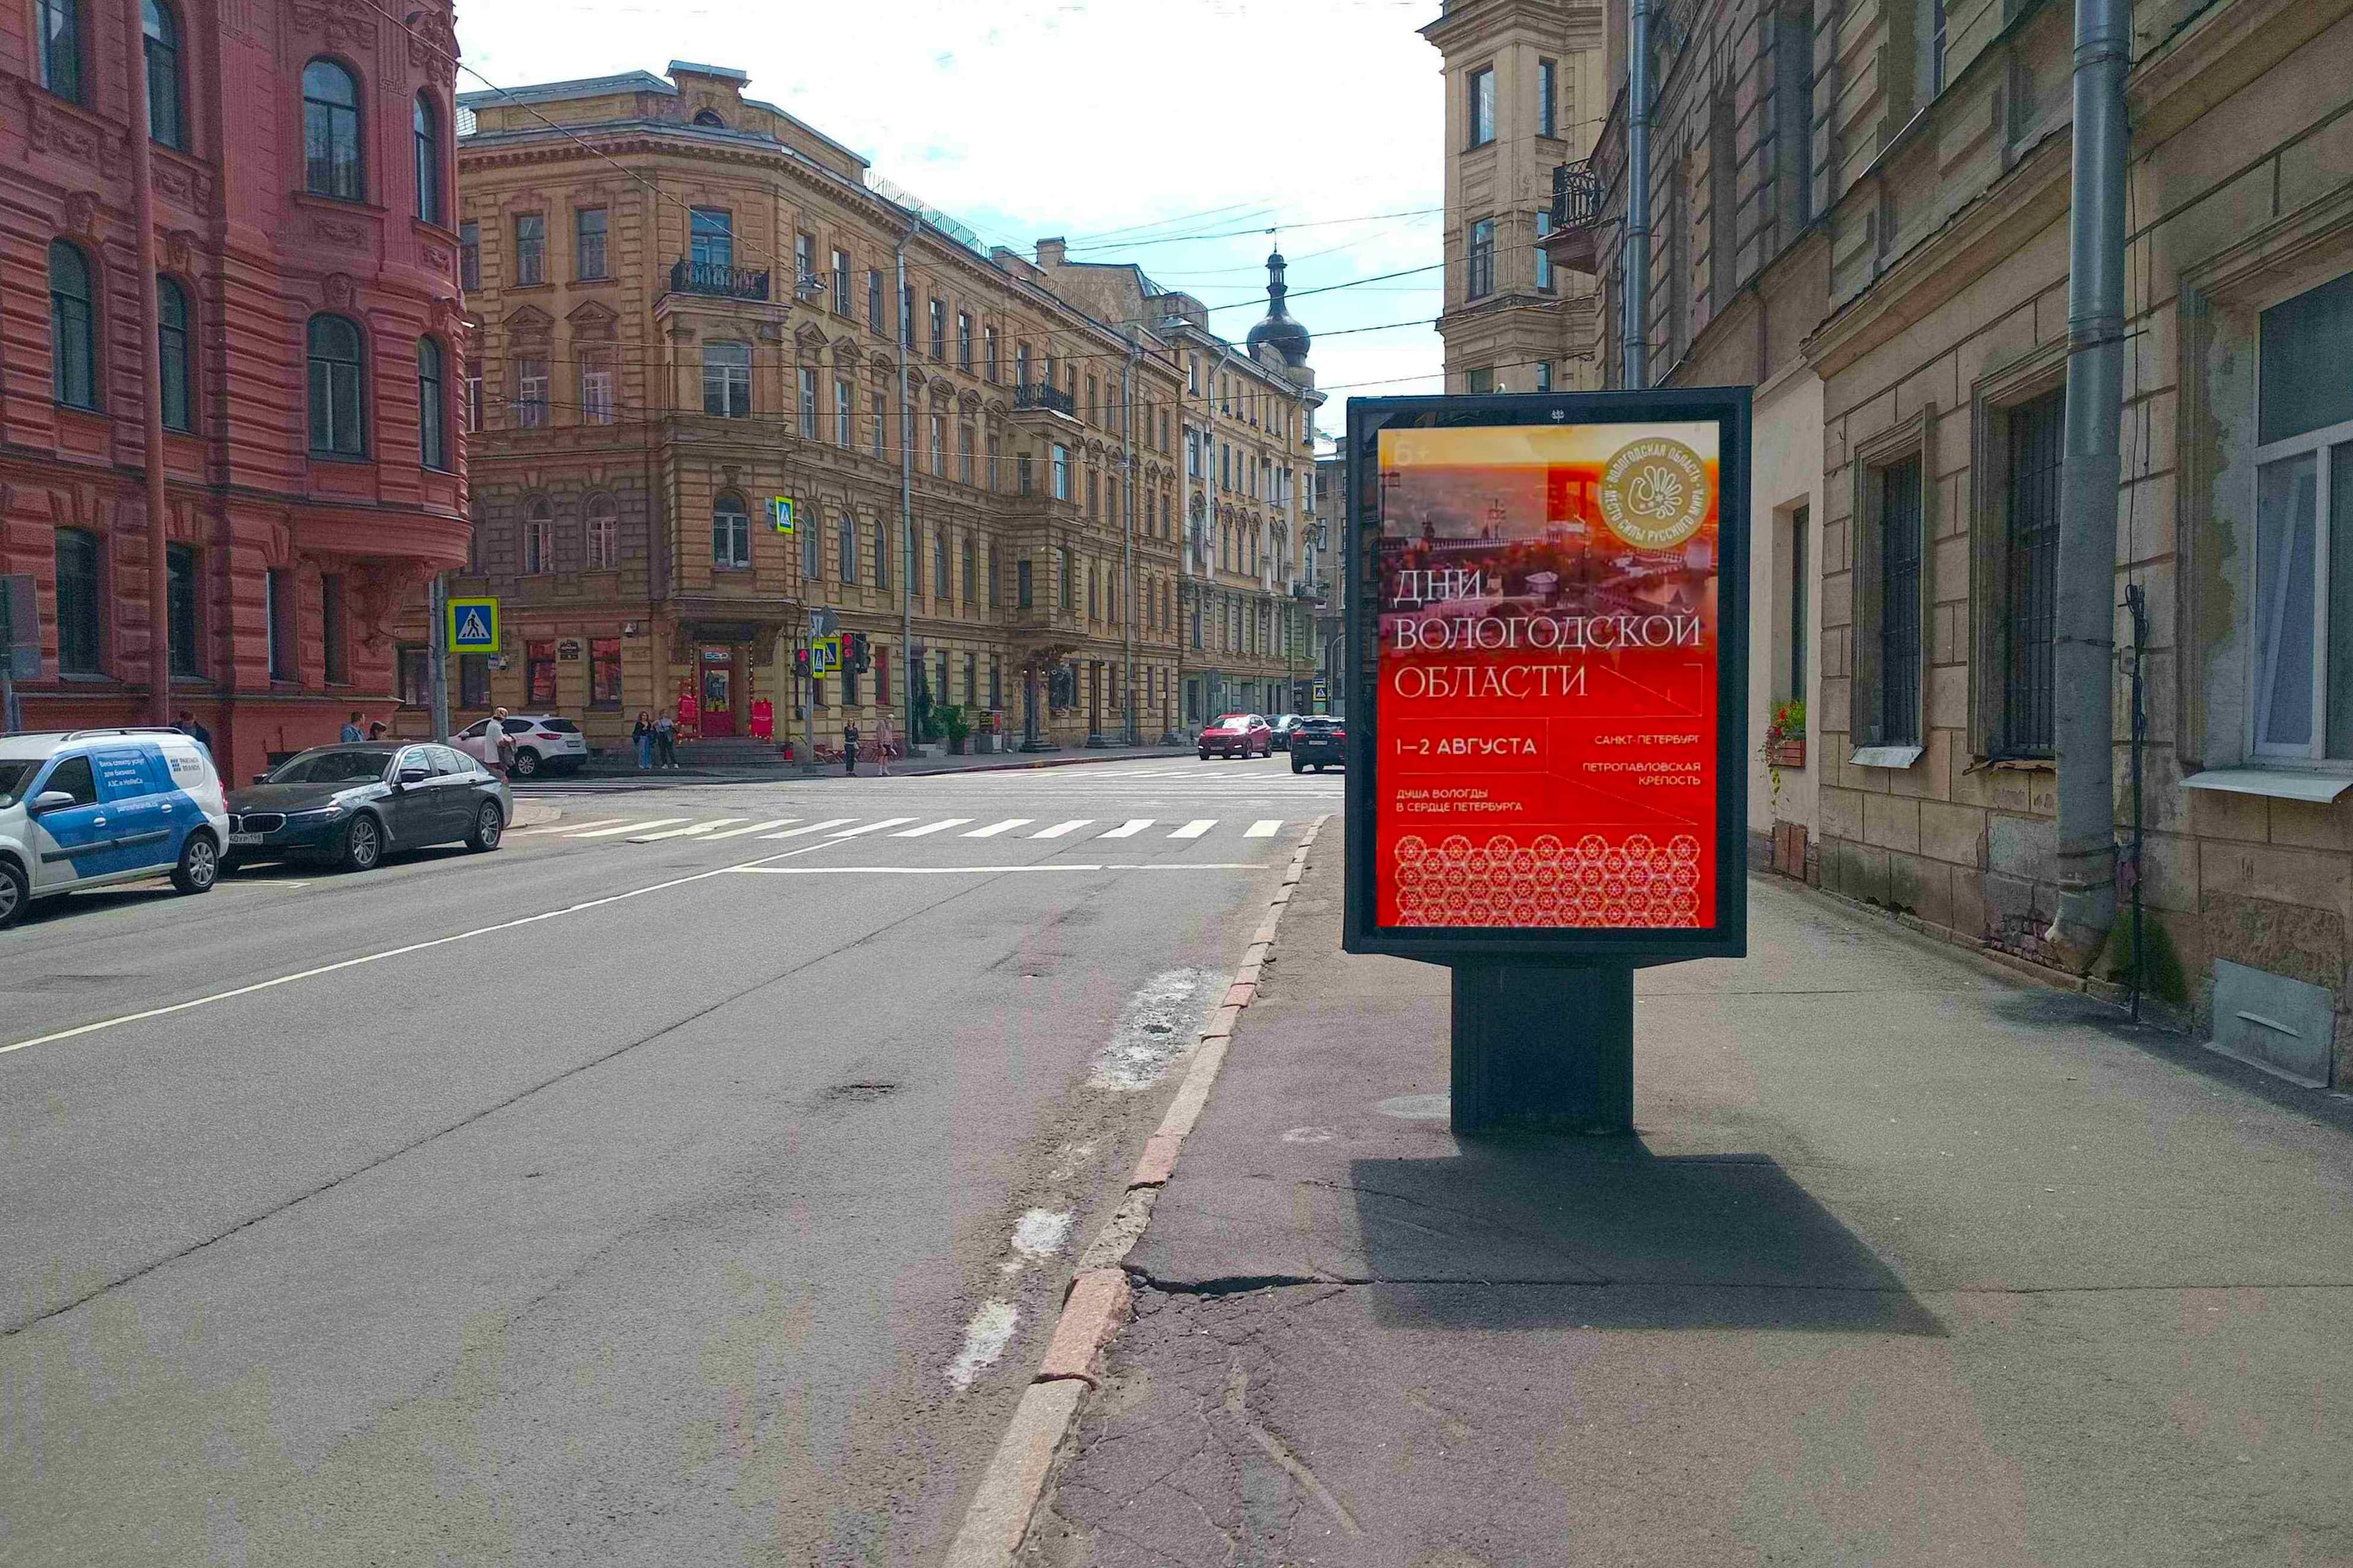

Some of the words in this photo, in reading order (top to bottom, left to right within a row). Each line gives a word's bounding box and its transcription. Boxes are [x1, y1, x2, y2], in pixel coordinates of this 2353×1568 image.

[1607, 443, 1667, 483] ВОЛОГОДСКАЯ
[1668, 447, 1702, 483] ОБЛАСТЬ
[1604, 490, 1623, 521] МЕСТО
[1618, 519, 1646, 540] СИЛЫ
[1648, 515, 1695, 542] РУССКОГО
[1688, 489, 1704, 516] МИРА
[1393, 568, 1484, 608] ДНИ
[1393, 607, 1703, 657] ВОЛОГОДСКОЙ
[1394, 665, 1588, 700] ОБЛАСТИ
[1437, 737, 1537, 755] АВГУСТА
[1594, 734, 1700, 745] САНКТ-ПЕТЕРБУРГ
[1583, 762, 1701, 772] ПЕТРОПАВЛОВСКАЯ
[1639, 775, 1701, 786] КРЕПОСТЬ
[1396, 789, 1430, 799] ДУША
[1432, 788, 1488, 799] ВОЛОГДЫ
[1396, 802, 1404, 812] В
[1407, 802, 1450, 812] СЕРДЦЕ
[1453, 801, 1523, 812] ПЕТЕРБУРГА
